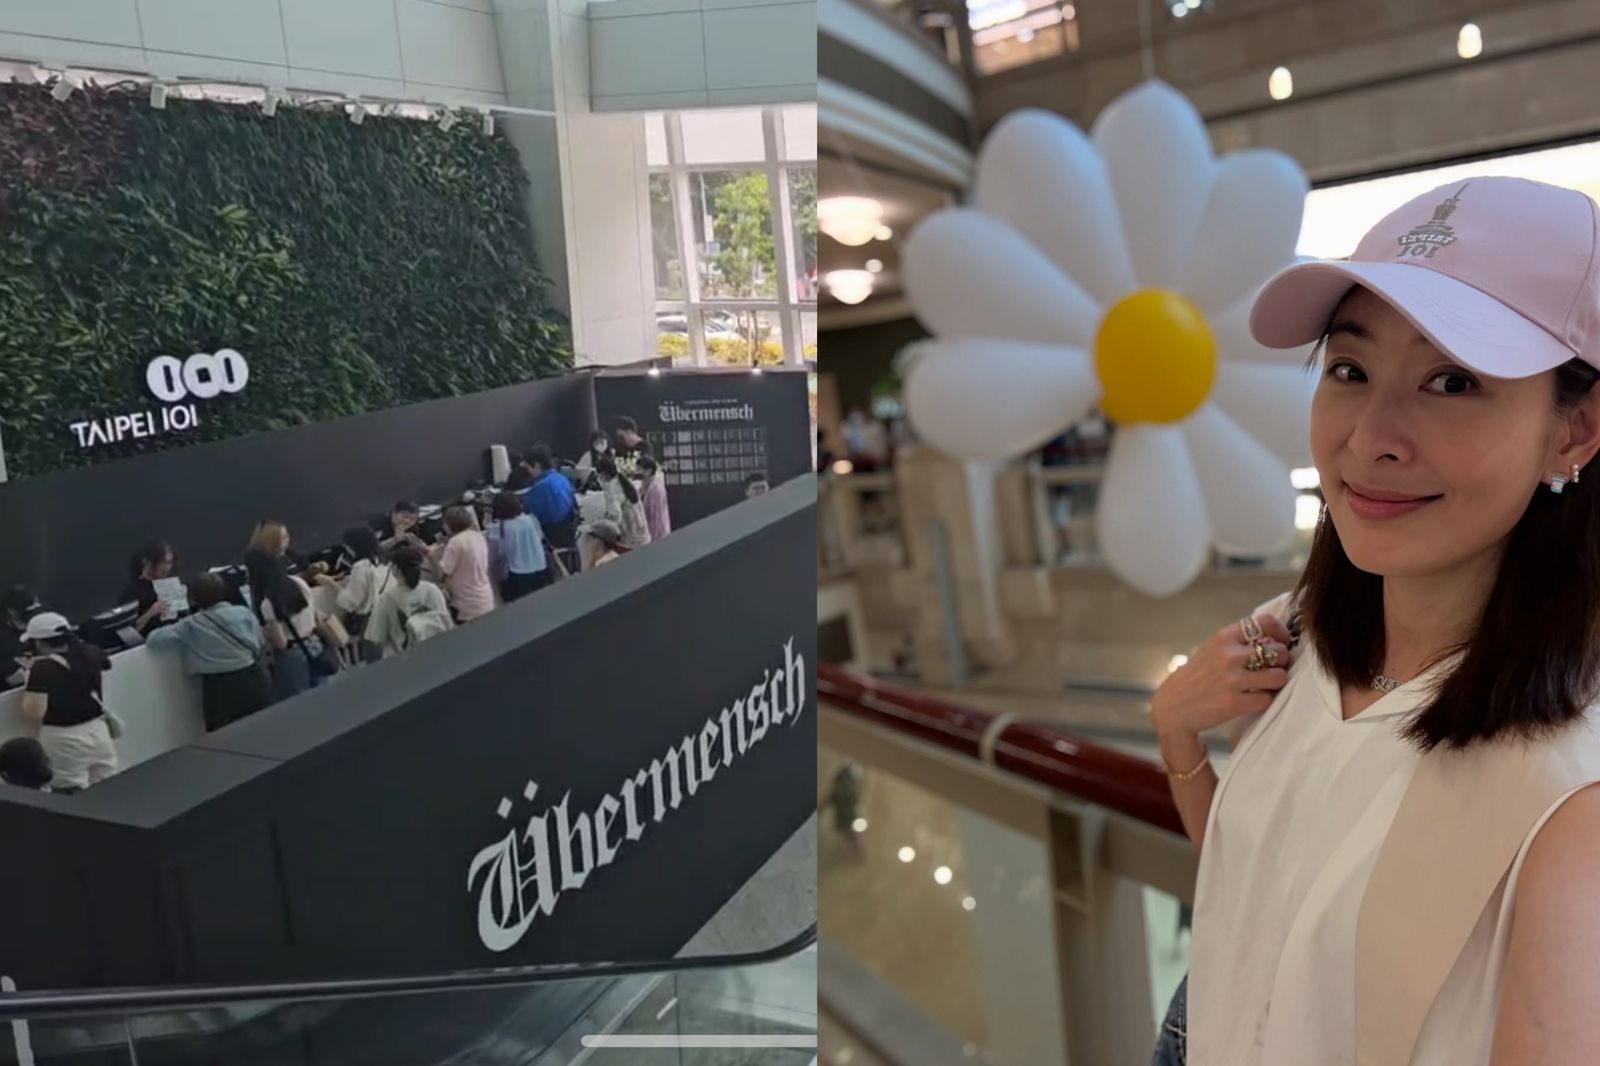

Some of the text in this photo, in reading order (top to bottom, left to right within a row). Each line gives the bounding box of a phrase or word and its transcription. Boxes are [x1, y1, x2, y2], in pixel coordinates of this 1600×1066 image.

[70, 411, 155, 448] TAIPEI
[659, 401, 754, 421] Übermensch
[467, 635, 806, 952] Übermensch
